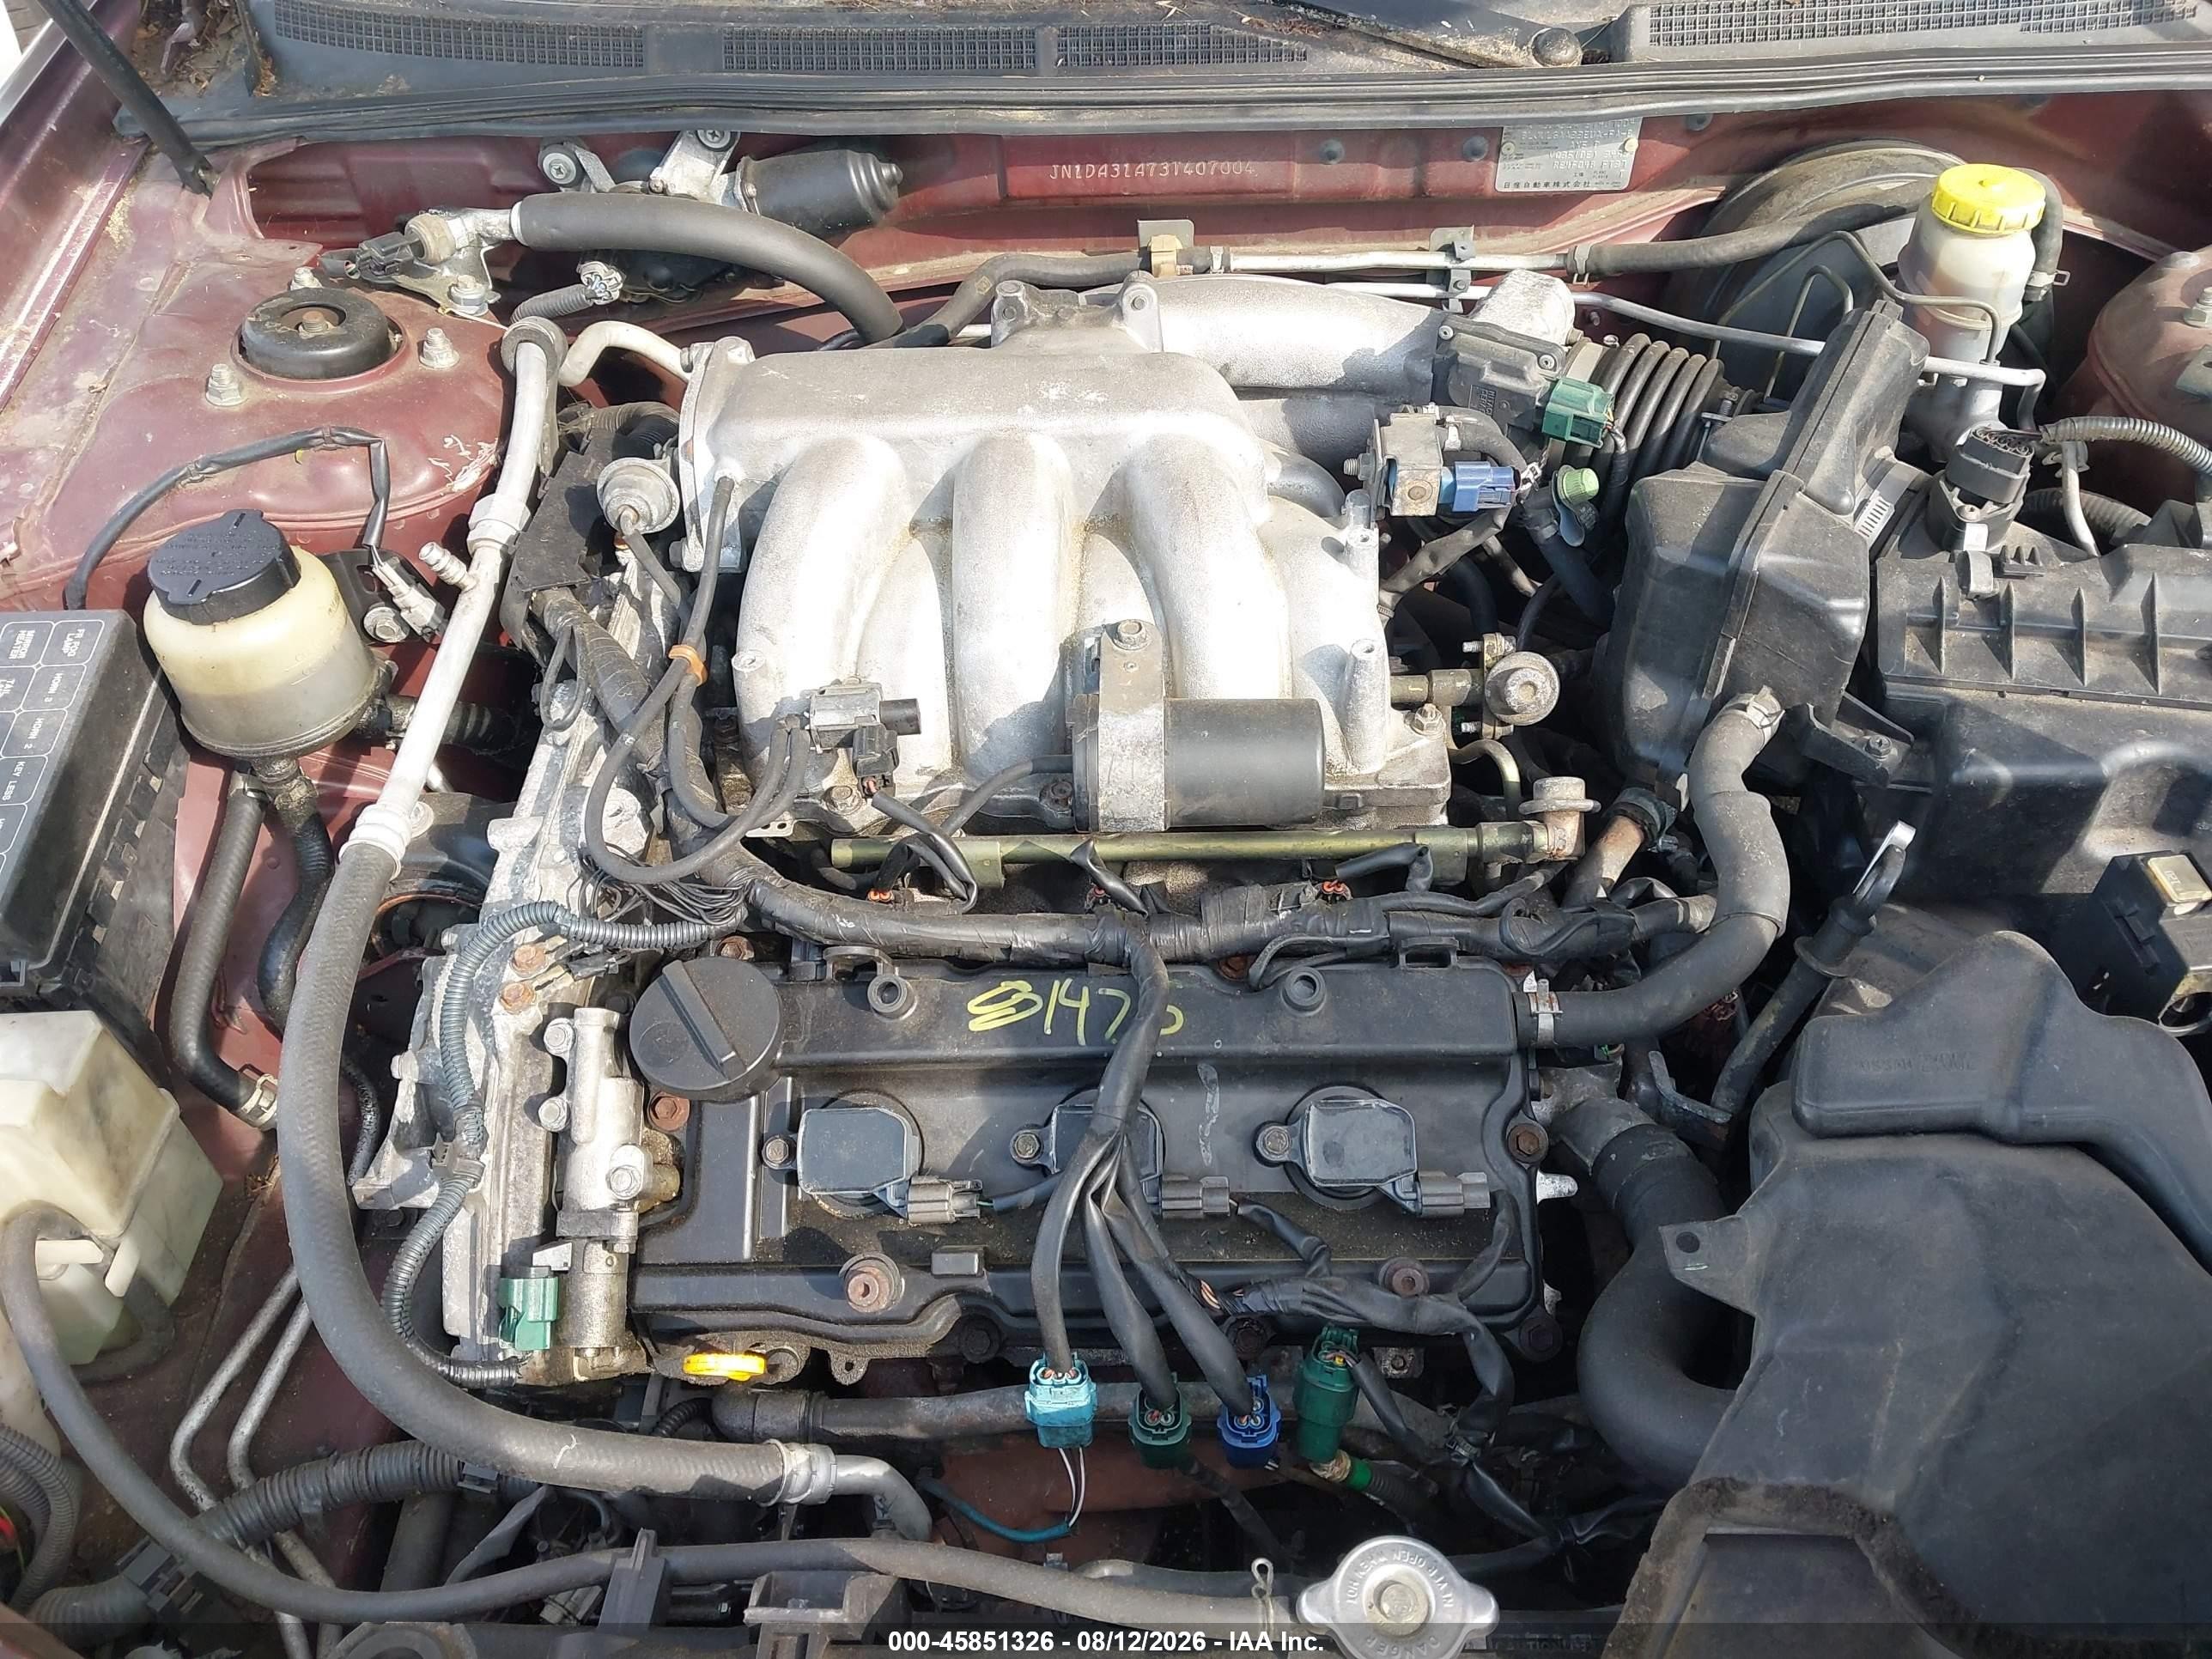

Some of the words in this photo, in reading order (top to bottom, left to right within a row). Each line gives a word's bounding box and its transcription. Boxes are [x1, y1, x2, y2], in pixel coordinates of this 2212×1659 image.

[8, 629, 27, 659] HEATER
[17, 629, 35, 659] MIRROR
[67, 641, 80, 657] FOG
[47, 672, 64, 694] HORN
[27, 717, 45, 739] HORN
[12, 761, 26, 777] KEY
[1393, 1550, 1427, 1568] OPEN
